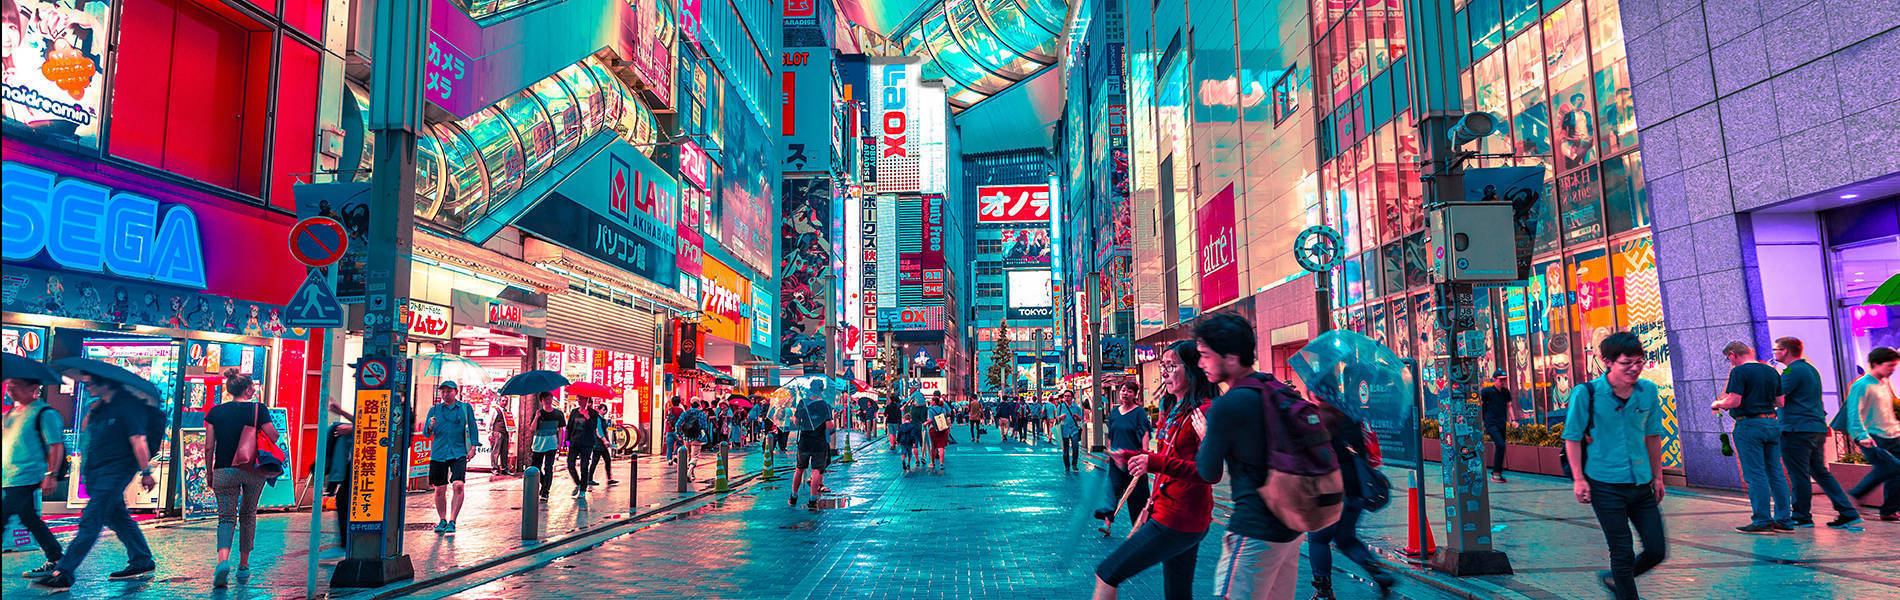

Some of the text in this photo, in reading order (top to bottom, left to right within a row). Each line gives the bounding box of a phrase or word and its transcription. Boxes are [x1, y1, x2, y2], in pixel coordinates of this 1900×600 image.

[634, 169, 676, 230] LABI
[2, 161, 207, 290] SEGA
[632, 214, 675, 250] AKIHABARA
[929, 198, 942, 252] Duty Free
[500, 304, 522, 321] LABI
[1019, 308, 1048, 316] TOKYO
[360, 399, 379, 517] 路上喫煙禁止です。
[414, 440, 432, 453] au
